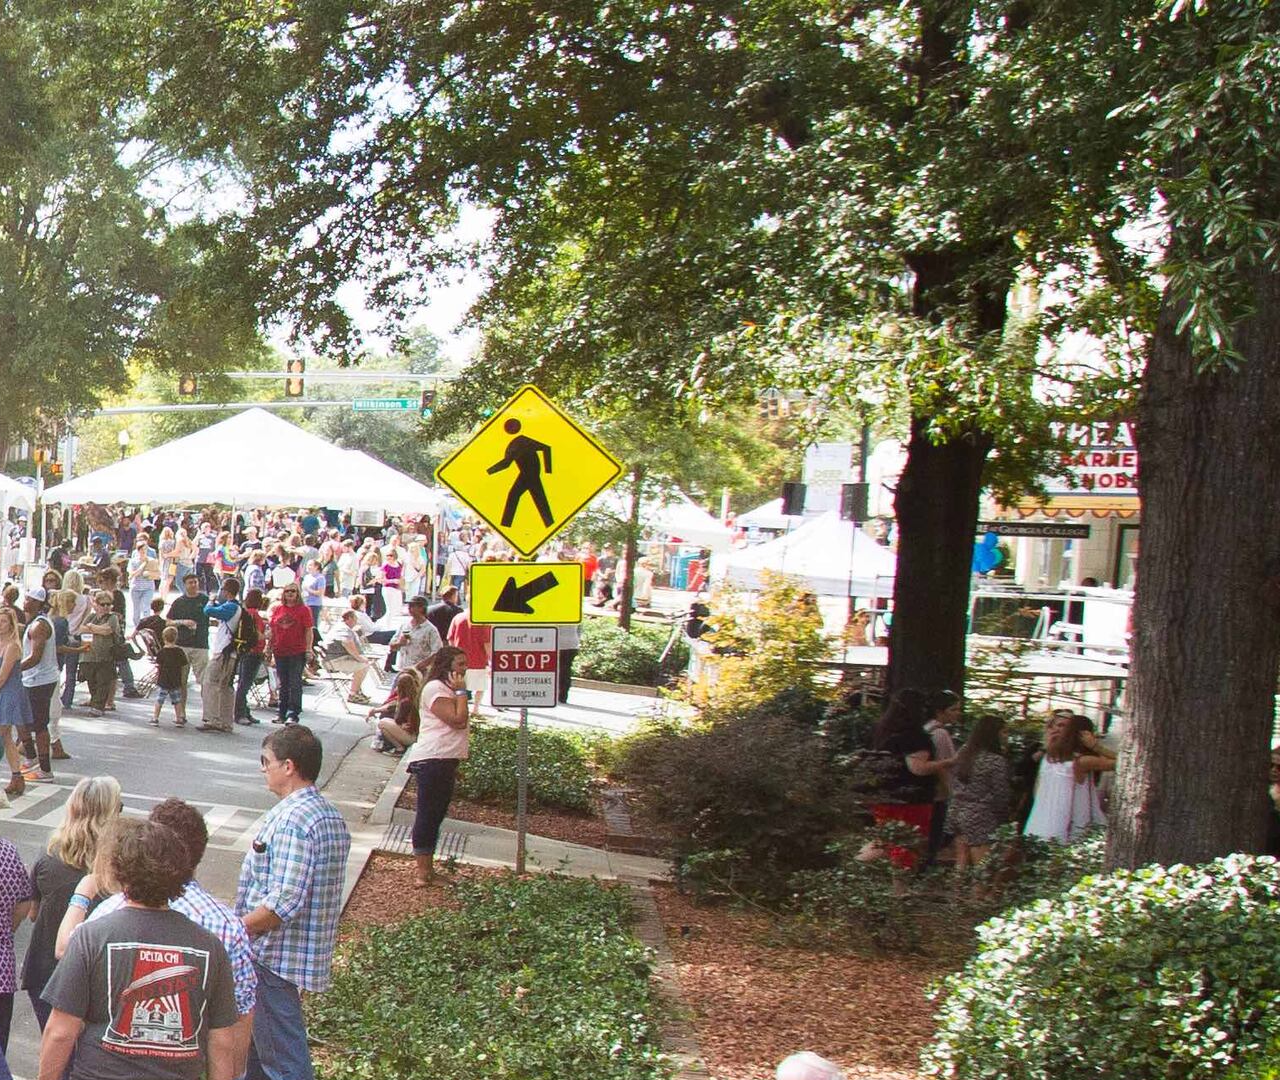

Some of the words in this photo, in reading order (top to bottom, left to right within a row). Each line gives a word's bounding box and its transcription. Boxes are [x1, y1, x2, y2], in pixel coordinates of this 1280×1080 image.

[355, 400, 401, 409] Wilkinson
[1048, 421, 1137, 446] THEA
[506, 636, 525, 644] STATE
[530, 636, 544, 644] LAW
[499, 653, 551, 669] STOP
[140, 950, 164, 963] DELTA
